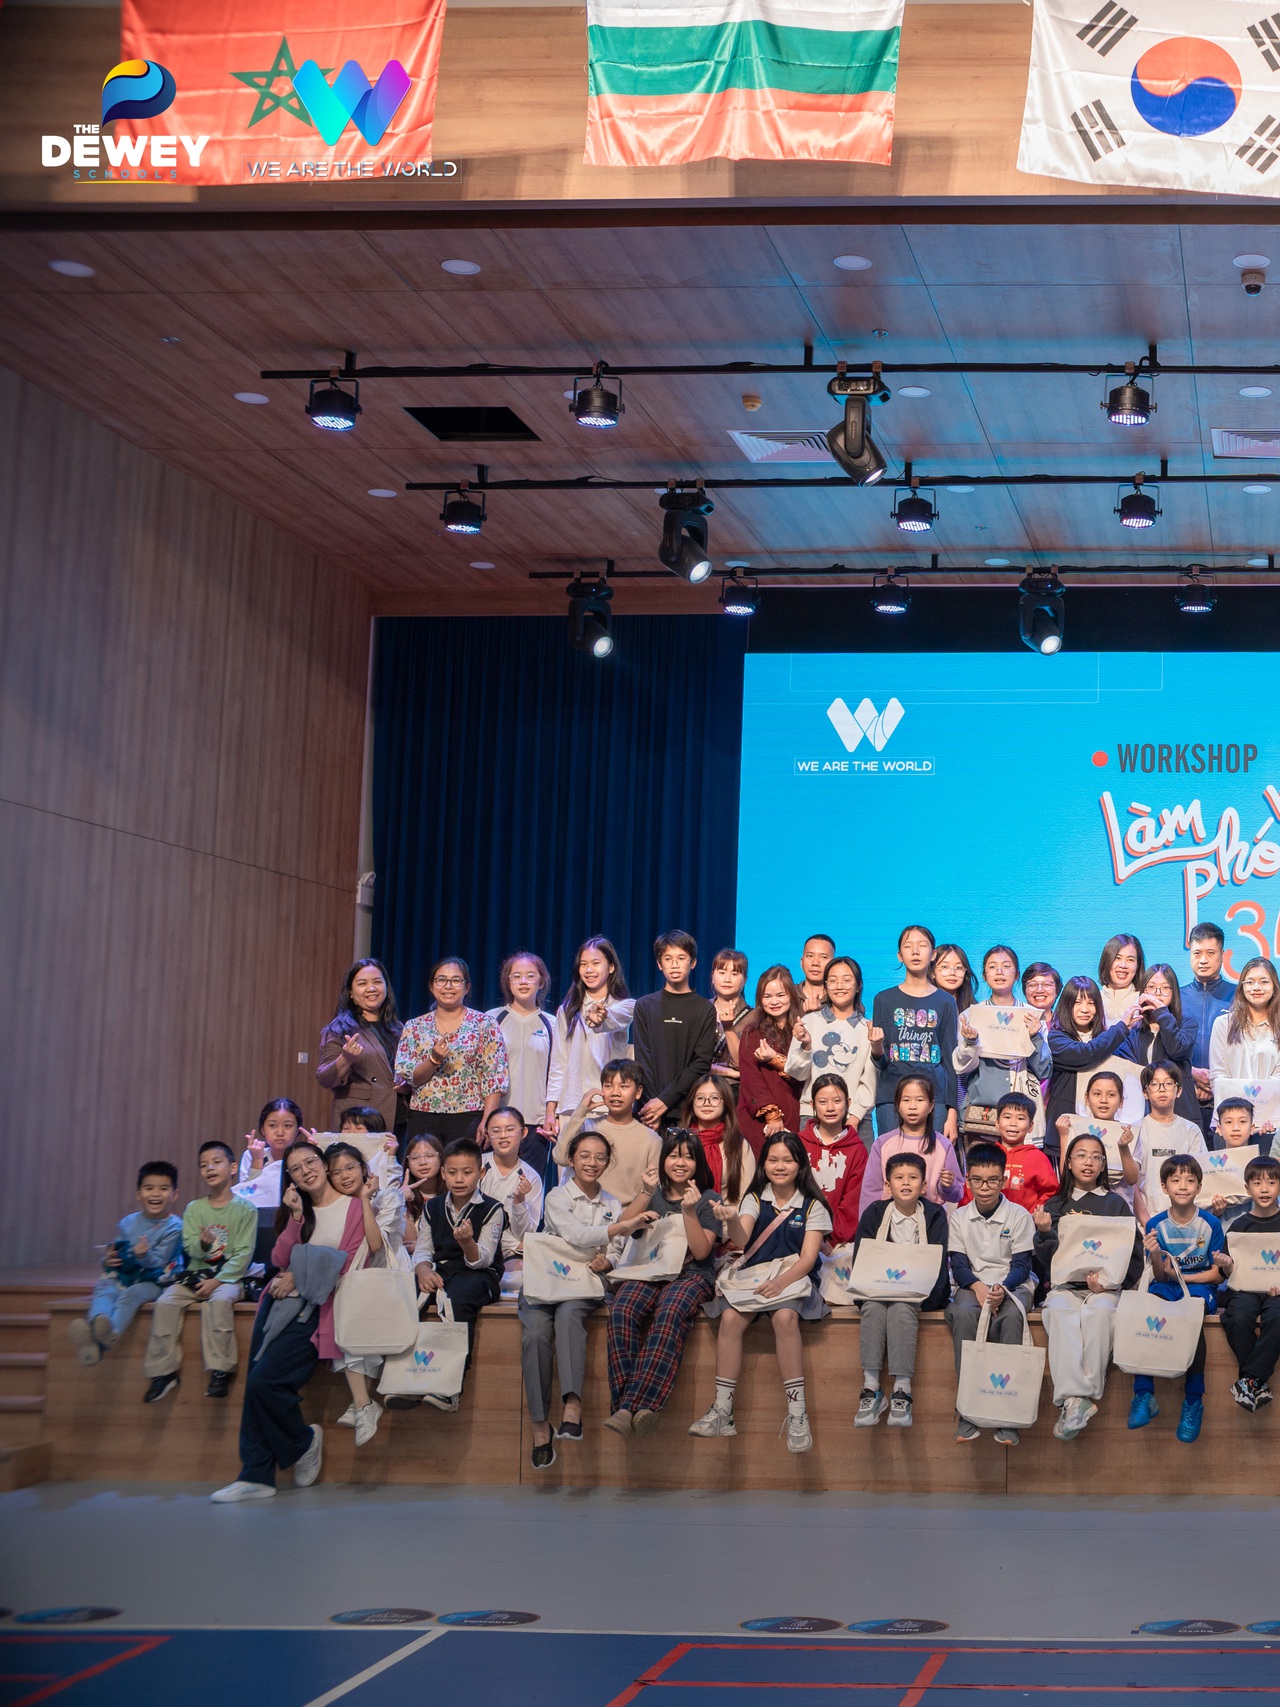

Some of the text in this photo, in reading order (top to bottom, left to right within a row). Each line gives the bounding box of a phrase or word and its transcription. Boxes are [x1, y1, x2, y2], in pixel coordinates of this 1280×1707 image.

[797, 761, 932, 772] WE ARE THE WORLD
[1117, 743, 1259, 773] WORKSHOP
[893, 1008, 938, 1028] GOOD
[898, 1027, 934, 1046] things
[889, 1042, 942, 1063] AHEAD
